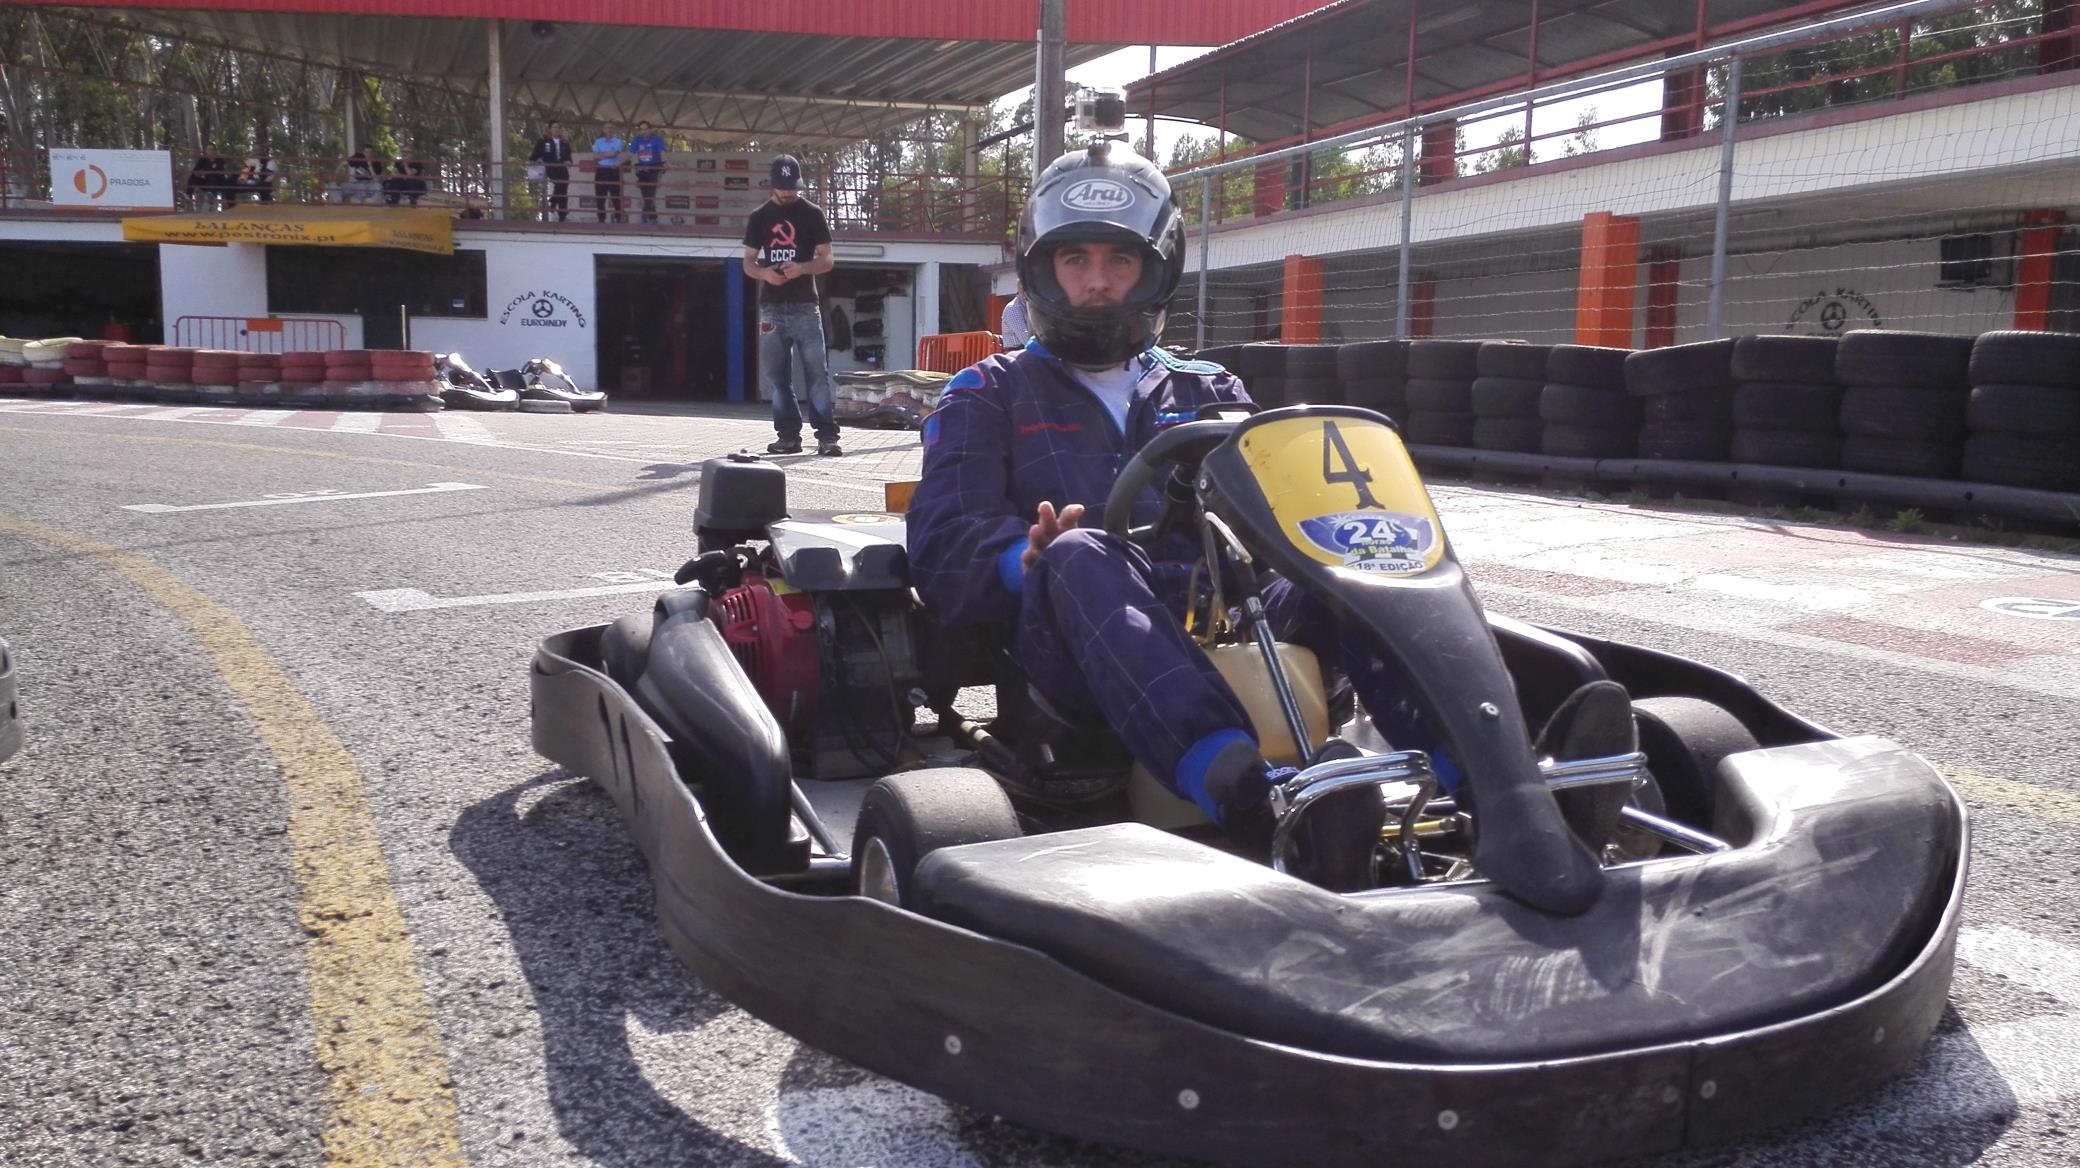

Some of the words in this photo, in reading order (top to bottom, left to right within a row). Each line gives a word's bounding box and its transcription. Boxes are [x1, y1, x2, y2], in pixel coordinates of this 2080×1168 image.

[1069, 183, 1126, 203] Arai
[770, 249, 796, 262] CCCP
[499, 290, 536, 326] ESCOLA
[542, 290, 587, 329] KARTING
[520, 318, 568, 328] EUROINDY
[1323, 420, 1386, 510] 4
